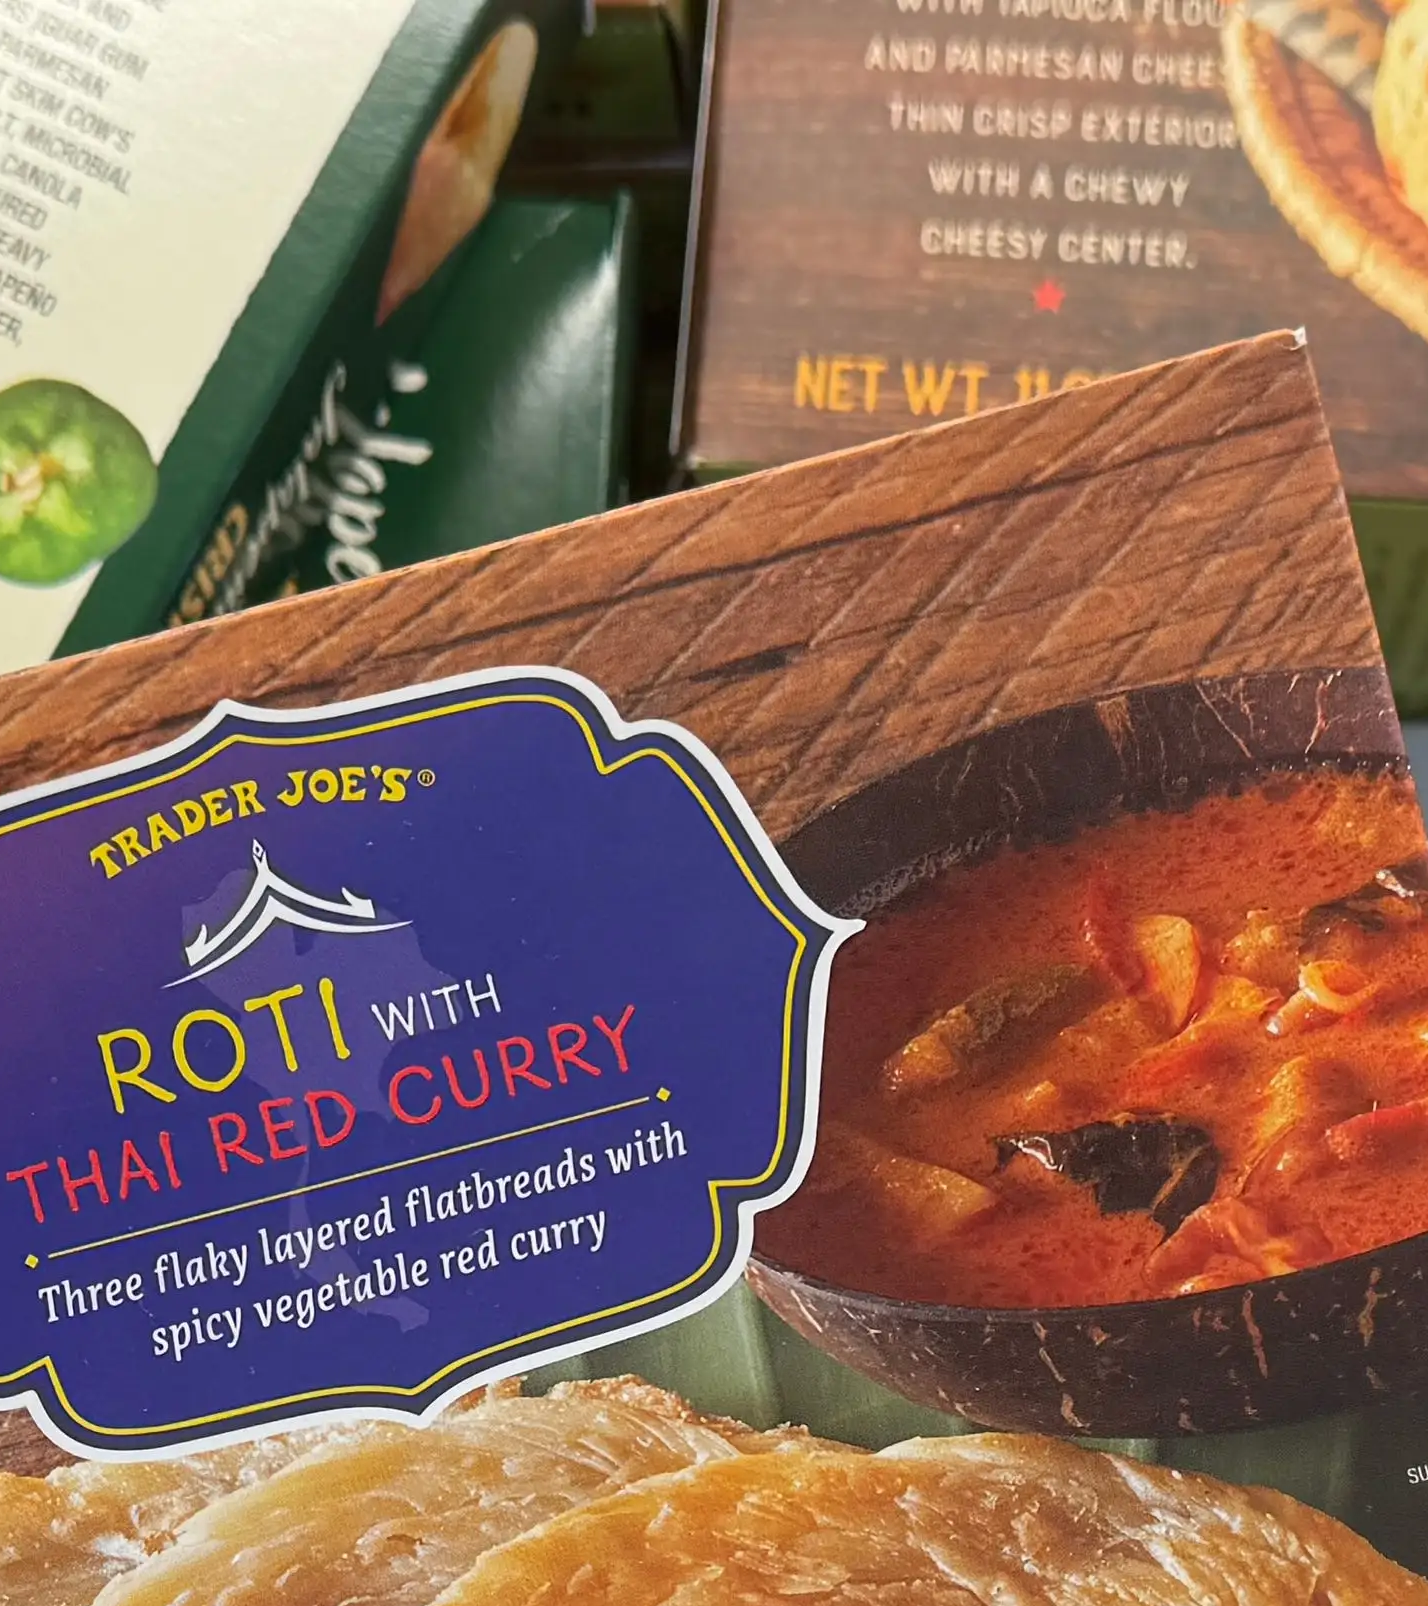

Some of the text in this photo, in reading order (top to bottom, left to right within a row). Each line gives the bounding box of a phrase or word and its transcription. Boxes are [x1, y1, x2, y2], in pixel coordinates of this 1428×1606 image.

[866, 36, 1123, 83] AND PARMESAN
[887, 97, 964, 134] THIN
[972, 99, 1072, 140] CRISP
[929, 160, 1190, 207] WITH A CHEWY
[920, 221, 1197, 269] CHEESY CENTER.
[794, 352, 888, 412] NET
[89, 780, 265, 878] TRADER
[98, 973, 501, 1113] ROTI WITH
[7, 1006, 634, 1223] THAI RED CURRY
[38, 1121, 688, 1323] Three flaky layered flatbreads with
[152, 1210, 605, 1362] spicy vegetable red curry
